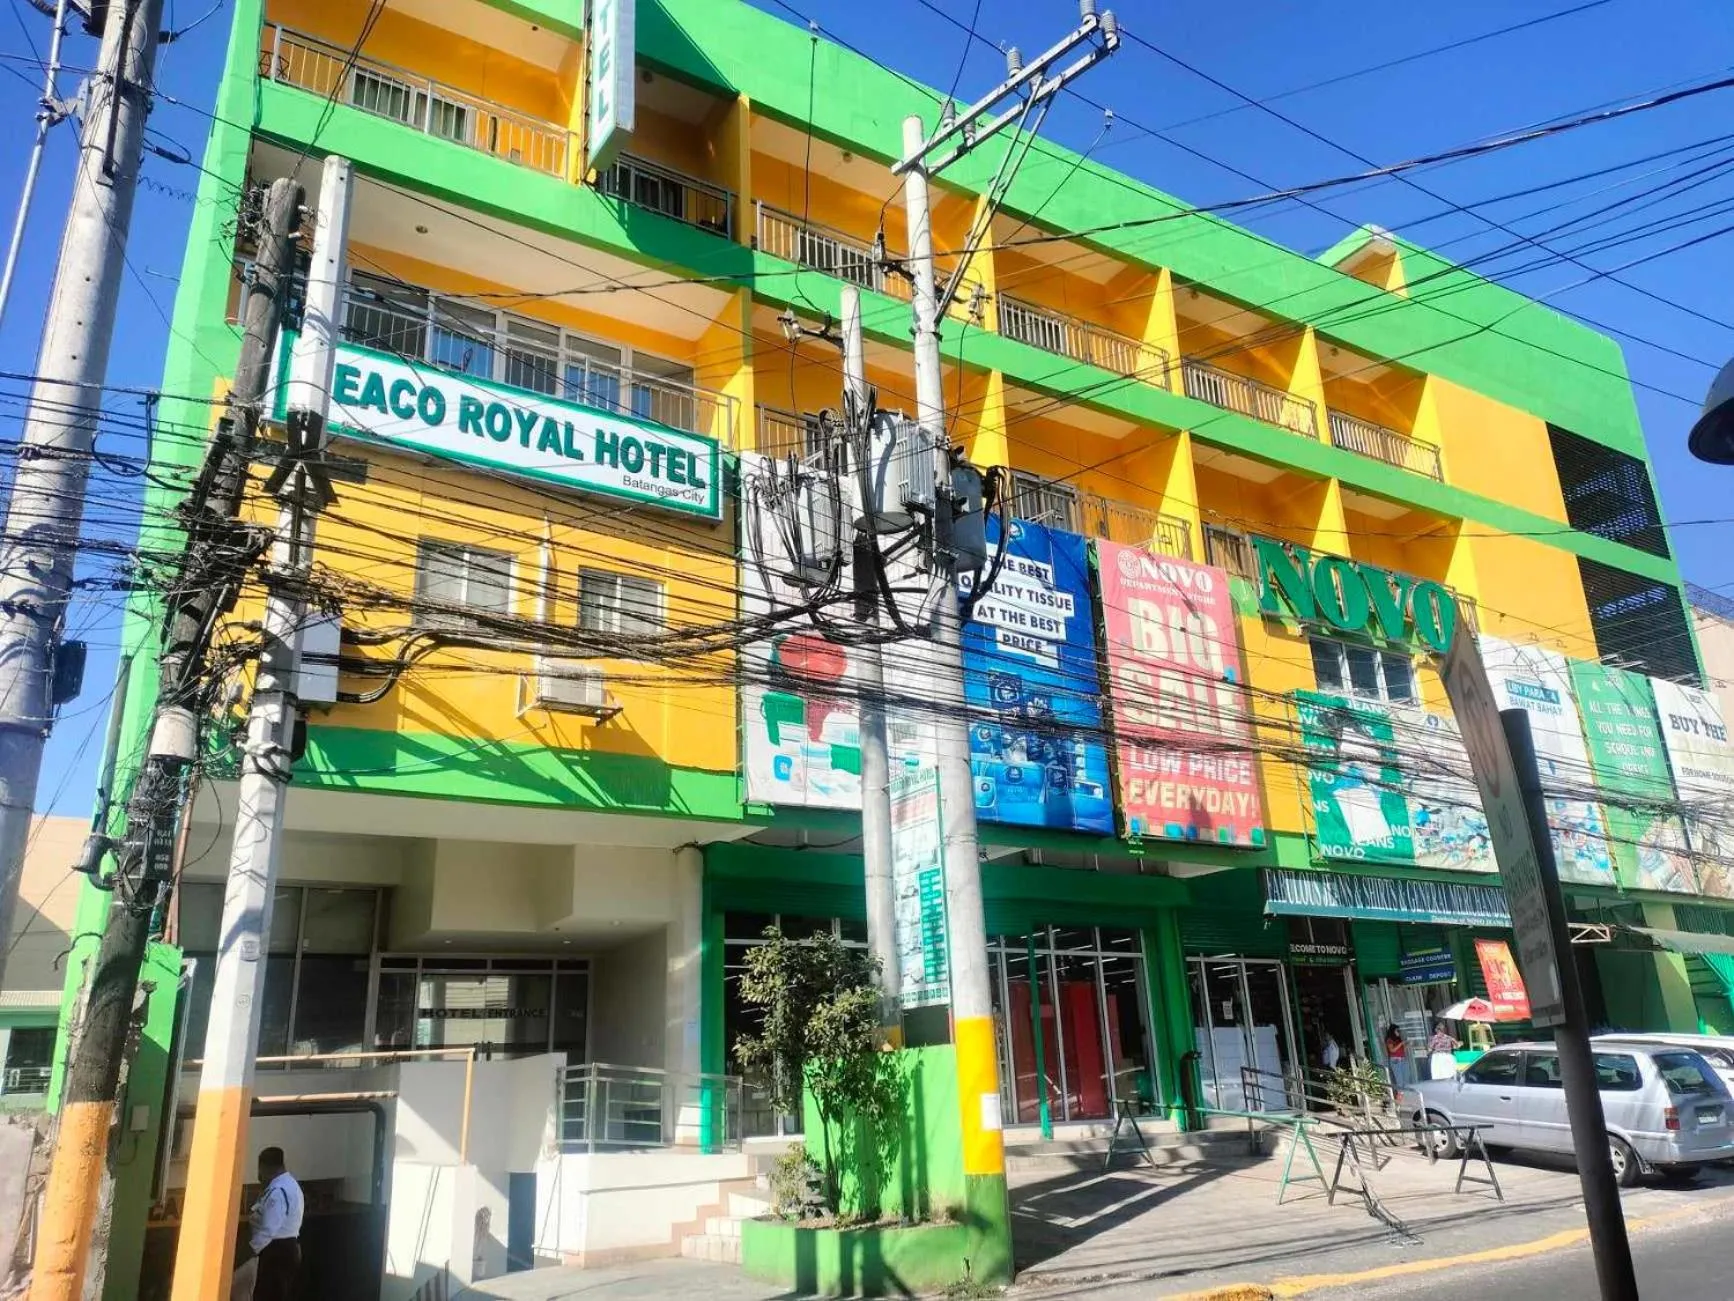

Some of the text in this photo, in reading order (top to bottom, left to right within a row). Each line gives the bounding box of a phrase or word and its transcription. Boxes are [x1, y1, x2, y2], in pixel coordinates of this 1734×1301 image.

[333, 363, 706, 490] EACO ROYAL HOTEL
[622, 474, 705, 505] Batangas City
[1019, 561, 1049, 581] BEST
[1139, 556, 1214, 593] NOVO
[960, 573, 1073, 612] QLITY TISSUE
[1251, 535, 1457, 653] NOVO
[977, 604, 1062, 634] AT THE BEST
[1002, 633, 1043, 654] PRICE
[1127, 597, 1225, 675] BIG
[1117, 662, 1247, 738] SALE
[1605, 702, 1623, 715] THE
[1597, 720, 1613, 735] YOU
[1668, 713, 1728, 742] BUY THE
[1130, 745, 1252, 785] LOW PRICE
[1128, 777, 1257, 818] EVERYDAY!
[1321, 844, 1366, 859] NOVO
[421, 1008, 545, 1019] HOTEL ENTRANCE
